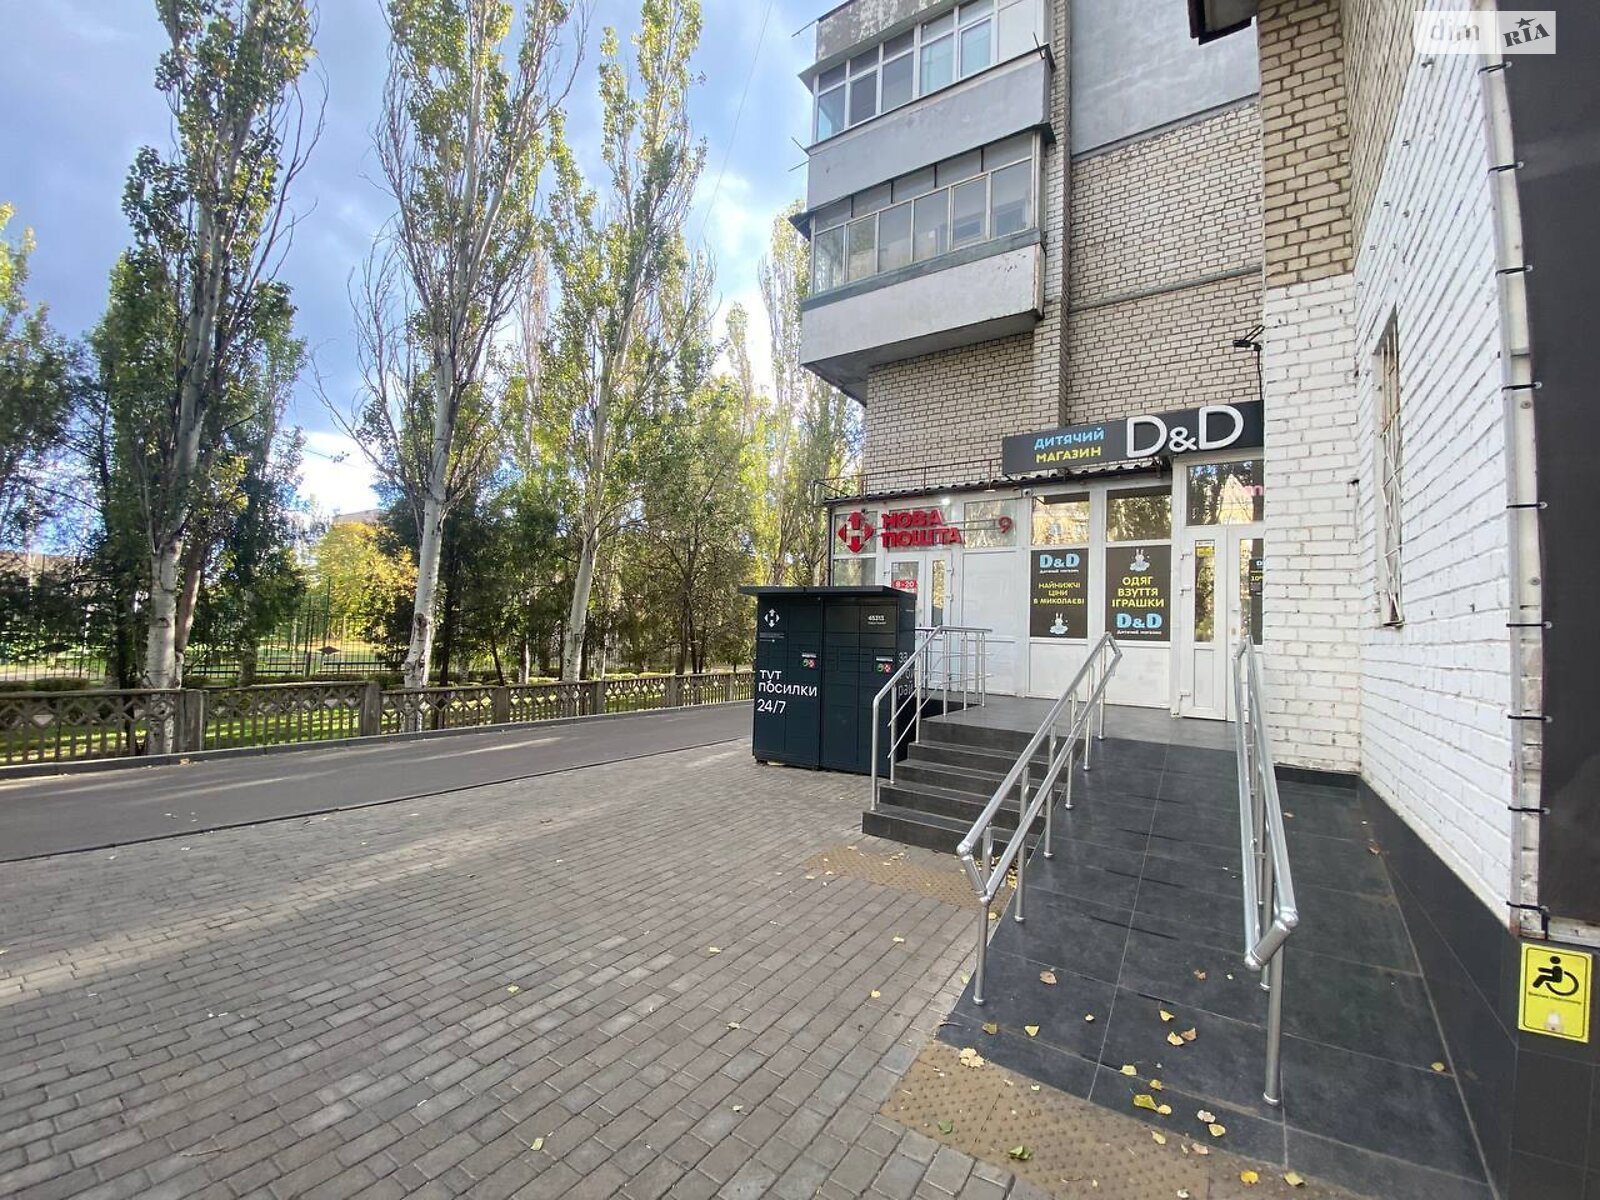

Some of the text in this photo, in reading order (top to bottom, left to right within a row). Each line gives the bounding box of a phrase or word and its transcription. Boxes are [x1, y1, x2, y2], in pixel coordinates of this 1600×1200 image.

[1034, 427, 1105, 450] ДИТЯЧИЙ
[1126, 404, 1245, 459] D&D
[1036, 446, 1102, 463] МАГАЗИН
[881, 509, 944, 530] НОВА
[998, 515, 1012, 534] 9
[881, 527, 965, 548] ПОШТА
[1039, 553, 1080, 568] D&D
[1038, 581, 1081, 590] НАЙНИЖЧІ
[1122, 576, 1154, 586] ОДЯГ
[1117, 587, 1159, 598] ВЗУТТЯ
[1112, 598, 1165, 608] ІГРАШКИ
[1116, 613, 1162, 629] D&D
[757, 698, 787, 714] 24/7
